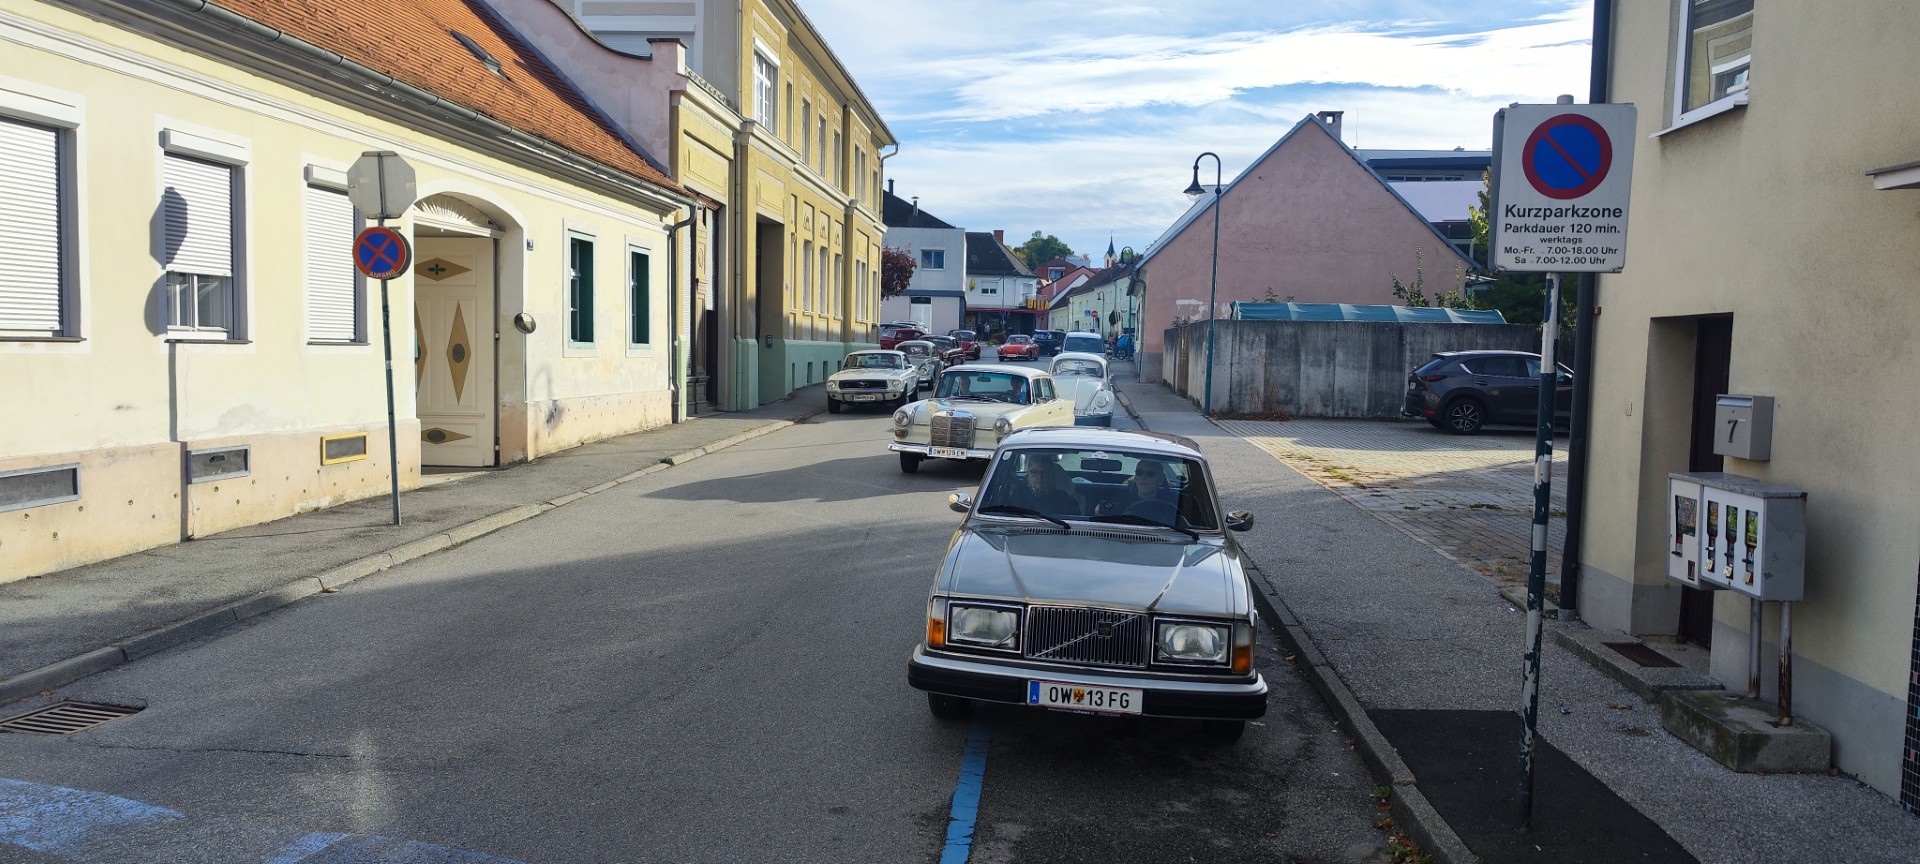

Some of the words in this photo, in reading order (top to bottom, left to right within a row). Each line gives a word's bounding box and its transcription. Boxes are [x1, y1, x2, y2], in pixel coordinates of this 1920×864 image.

[1504, 204, 1623, 221] Kurzparkzone
[1504, 223, 1566, 234] Parkdauer
[1570, 223, 1592, 234] 120
[1595, 223, 1621, 234] min.
[1539, 236, 1583, 245] werktags
[1547, 246, 1599, 255] 7.00-18.00
[1601, 246, 1619, 255] Uhr
[1514, 256, 1527, 264] Sa
[1535, 256, 1587, 265] 7.00-12.00
[1589, 256, 1606, 265] Uhr
[1727, 419, 1739, 443] 7
[1049, 686, 1073, 704] OW
[1086, 689, 1104, 707] 13
[1108, 691, 1130, 709] FG
